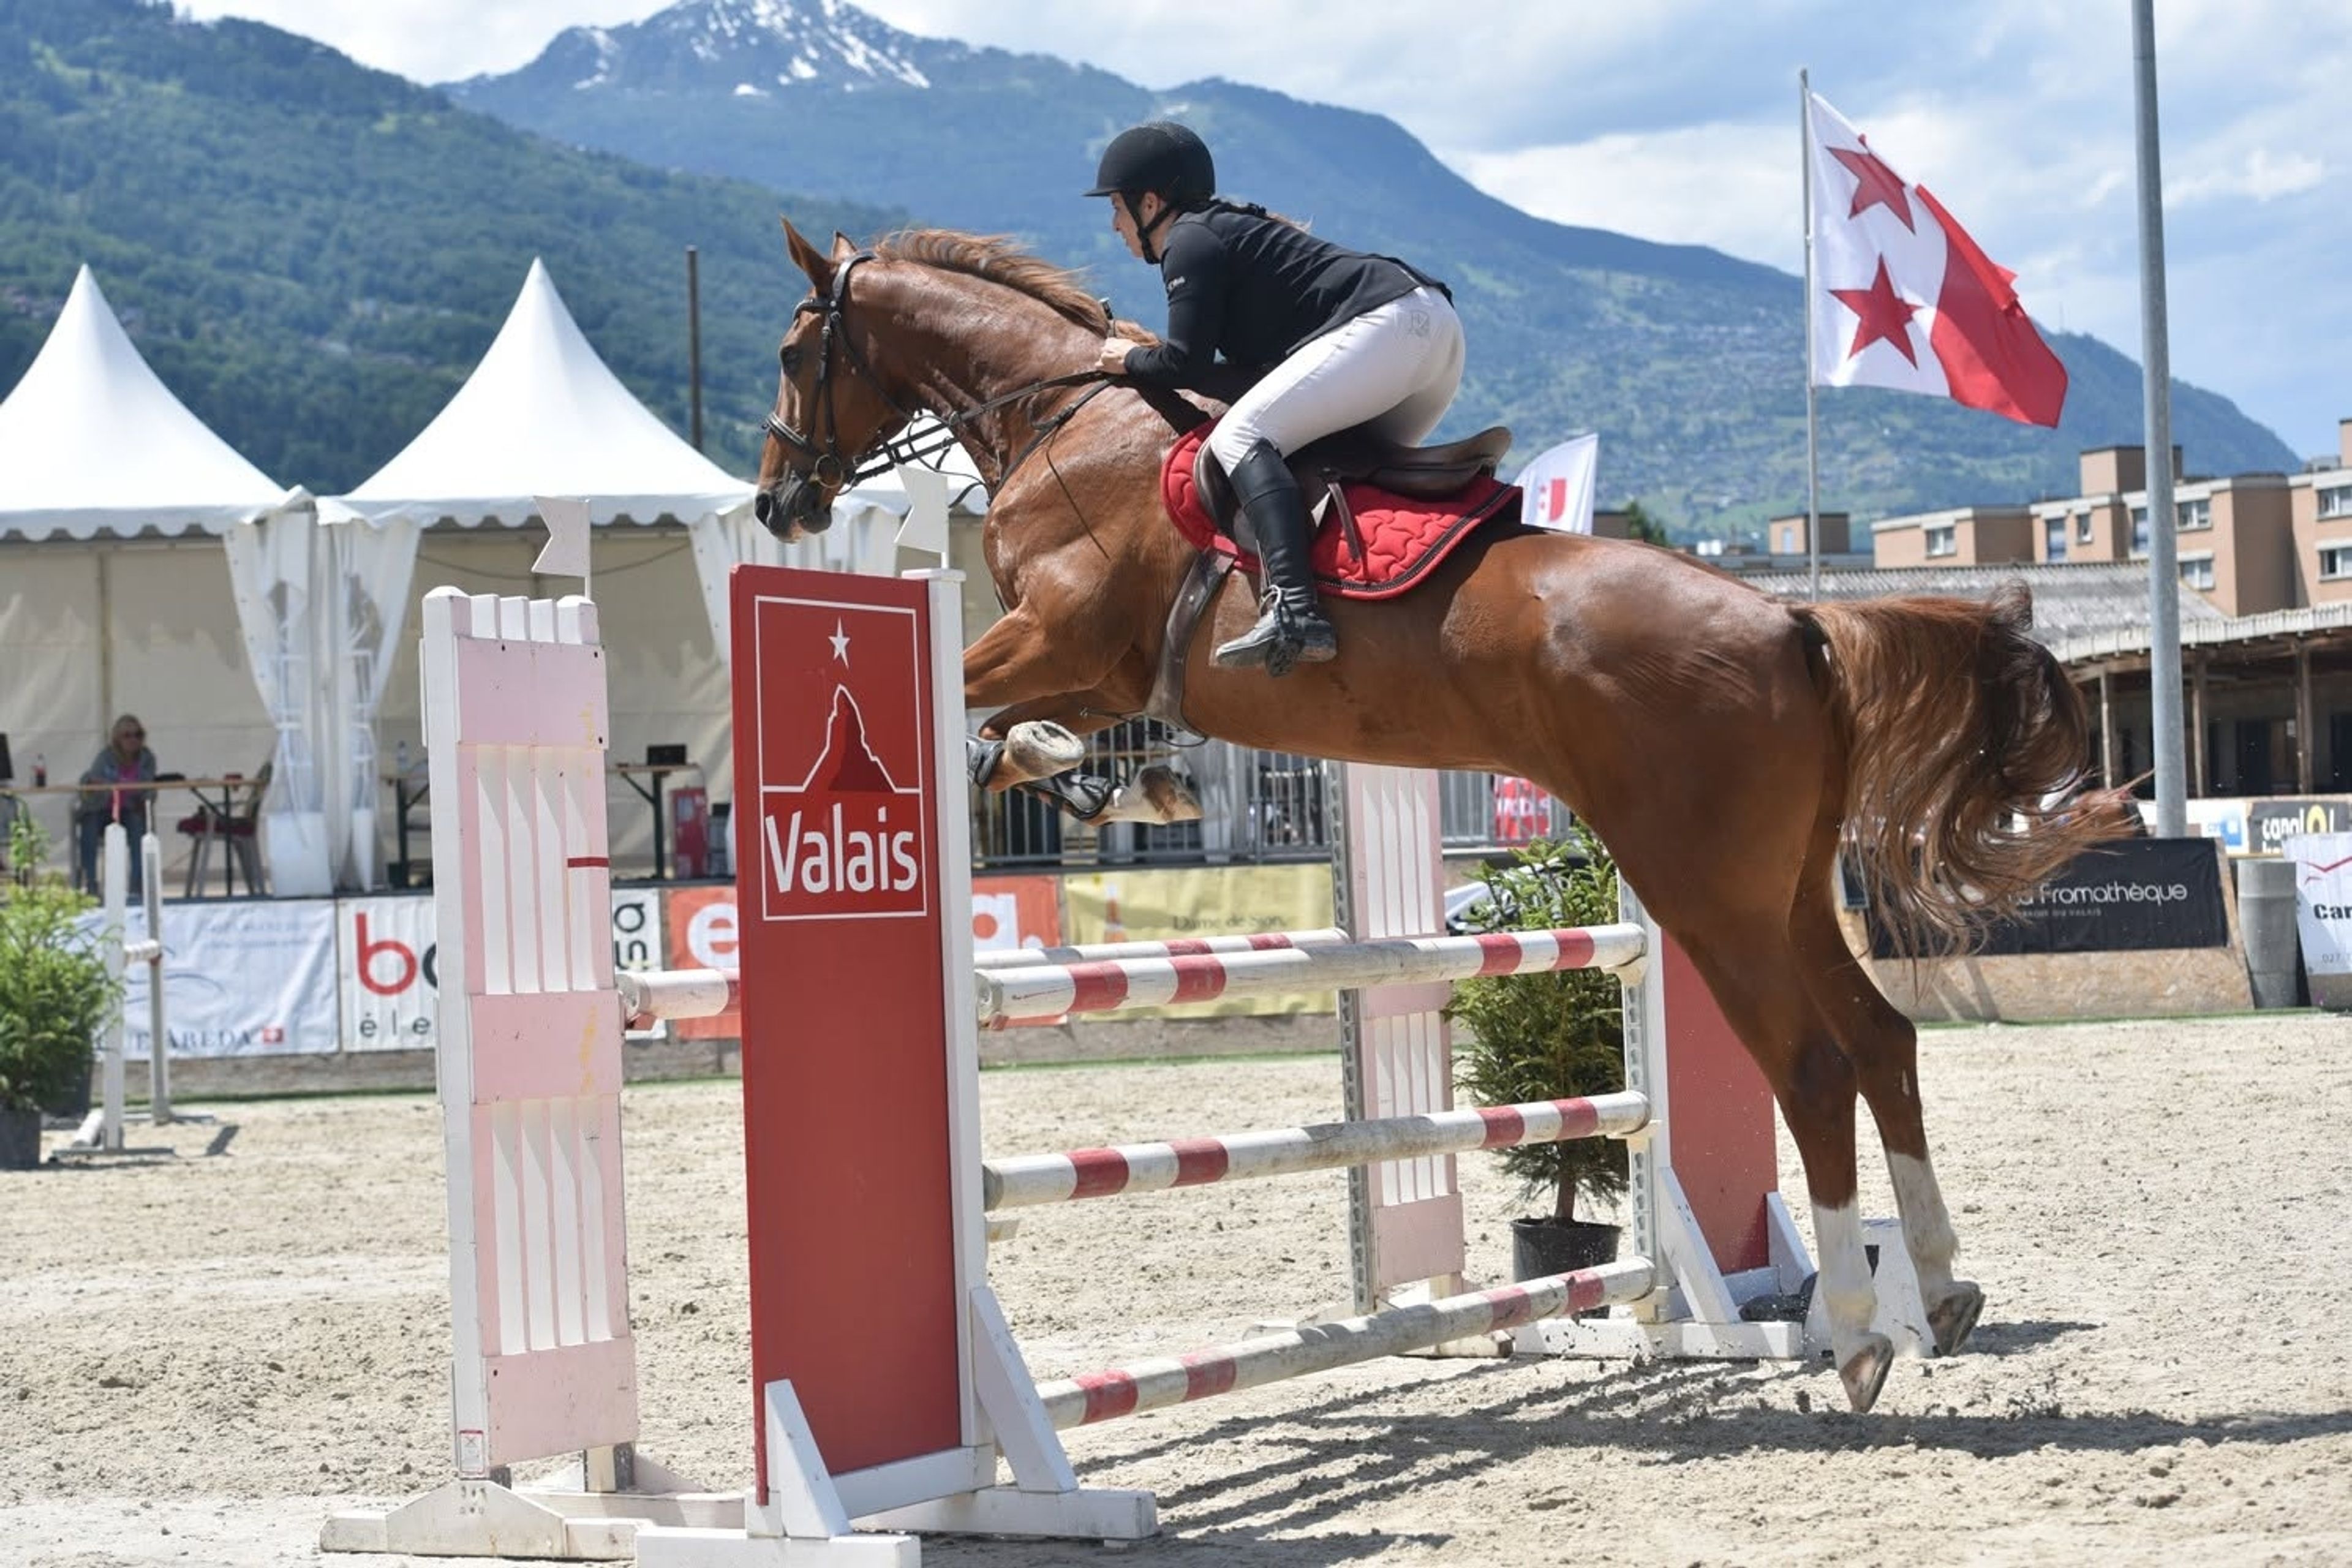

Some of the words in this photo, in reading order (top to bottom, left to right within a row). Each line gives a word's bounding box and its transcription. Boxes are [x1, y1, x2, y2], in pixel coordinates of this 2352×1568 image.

[764, 802, 918, 894] Valais
[2040, 880, 2188, 907] Fromathèque
[355, 912, 437, 995] b
